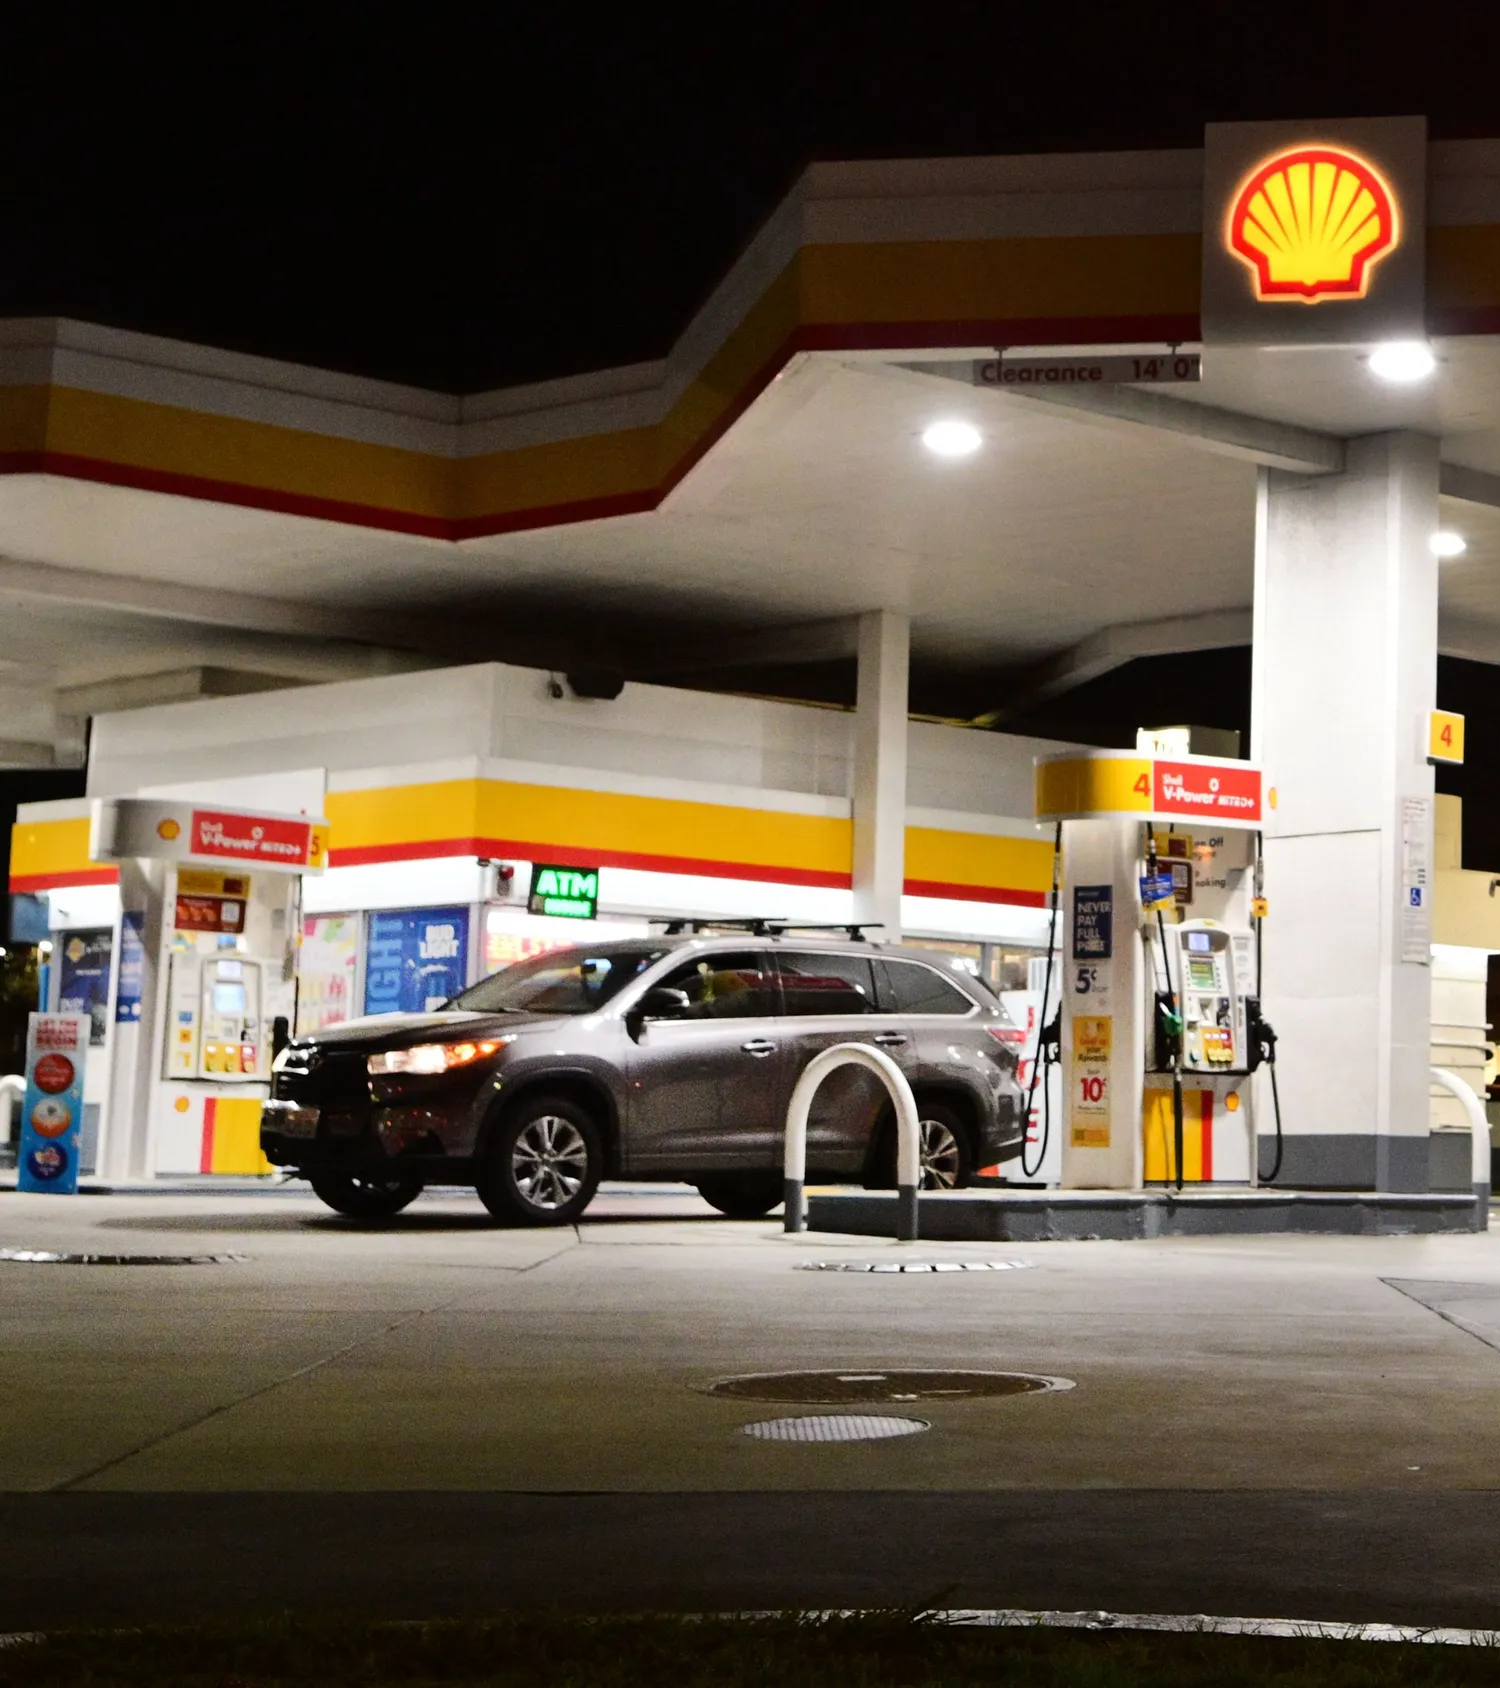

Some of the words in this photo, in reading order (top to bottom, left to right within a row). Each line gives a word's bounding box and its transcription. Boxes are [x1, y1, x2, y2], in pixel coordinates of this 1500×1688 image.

[980, 361, 1103, 384] Clearance
[1440, 724, 1453, 748] 4
[1132, 773, 1151, 798] 4
[1163, 785, 1217, 805] V-Power
[202, 831, 258, 850] V-Power
[310, 835, 320, 856] 5
[536, 870, 598, 899] ATM
[1077, 901, 1112, 914] NEVER
[1077, 914, 1098, 927] PAY
[425, 924, 456, 942] BUD
[1077, 927, 1101, 939] FULL
[418, 939, 460, 960] LIGHT
[366, 916, 404, 1013] IGHT
